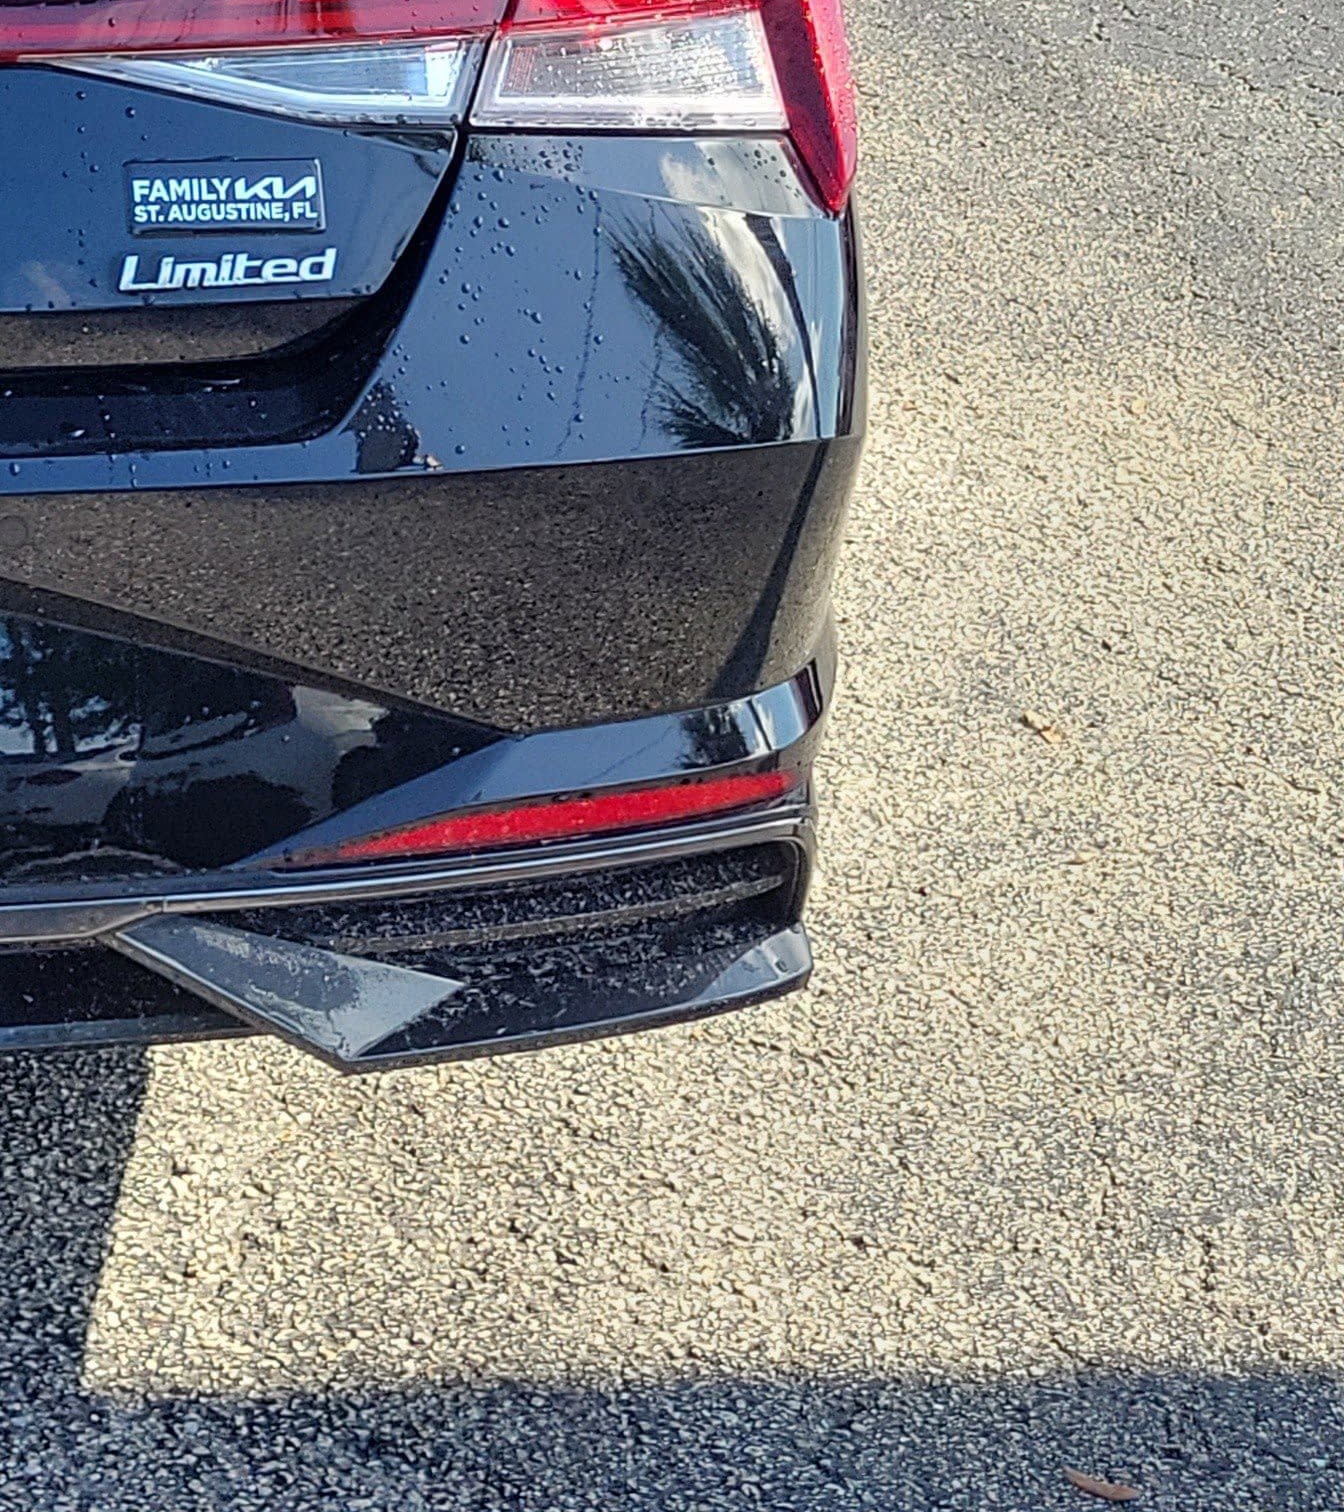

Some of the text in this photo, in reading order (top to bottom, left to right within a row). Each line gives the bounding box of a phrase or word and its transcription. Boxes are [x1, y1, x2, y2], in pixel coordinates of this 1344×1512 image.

[132, 176, 316, 203] FAMILY KIA
[134, 201, 318, 223] ST. AUGUSTINE, FL
[118, 247, 337, 292] Limited
